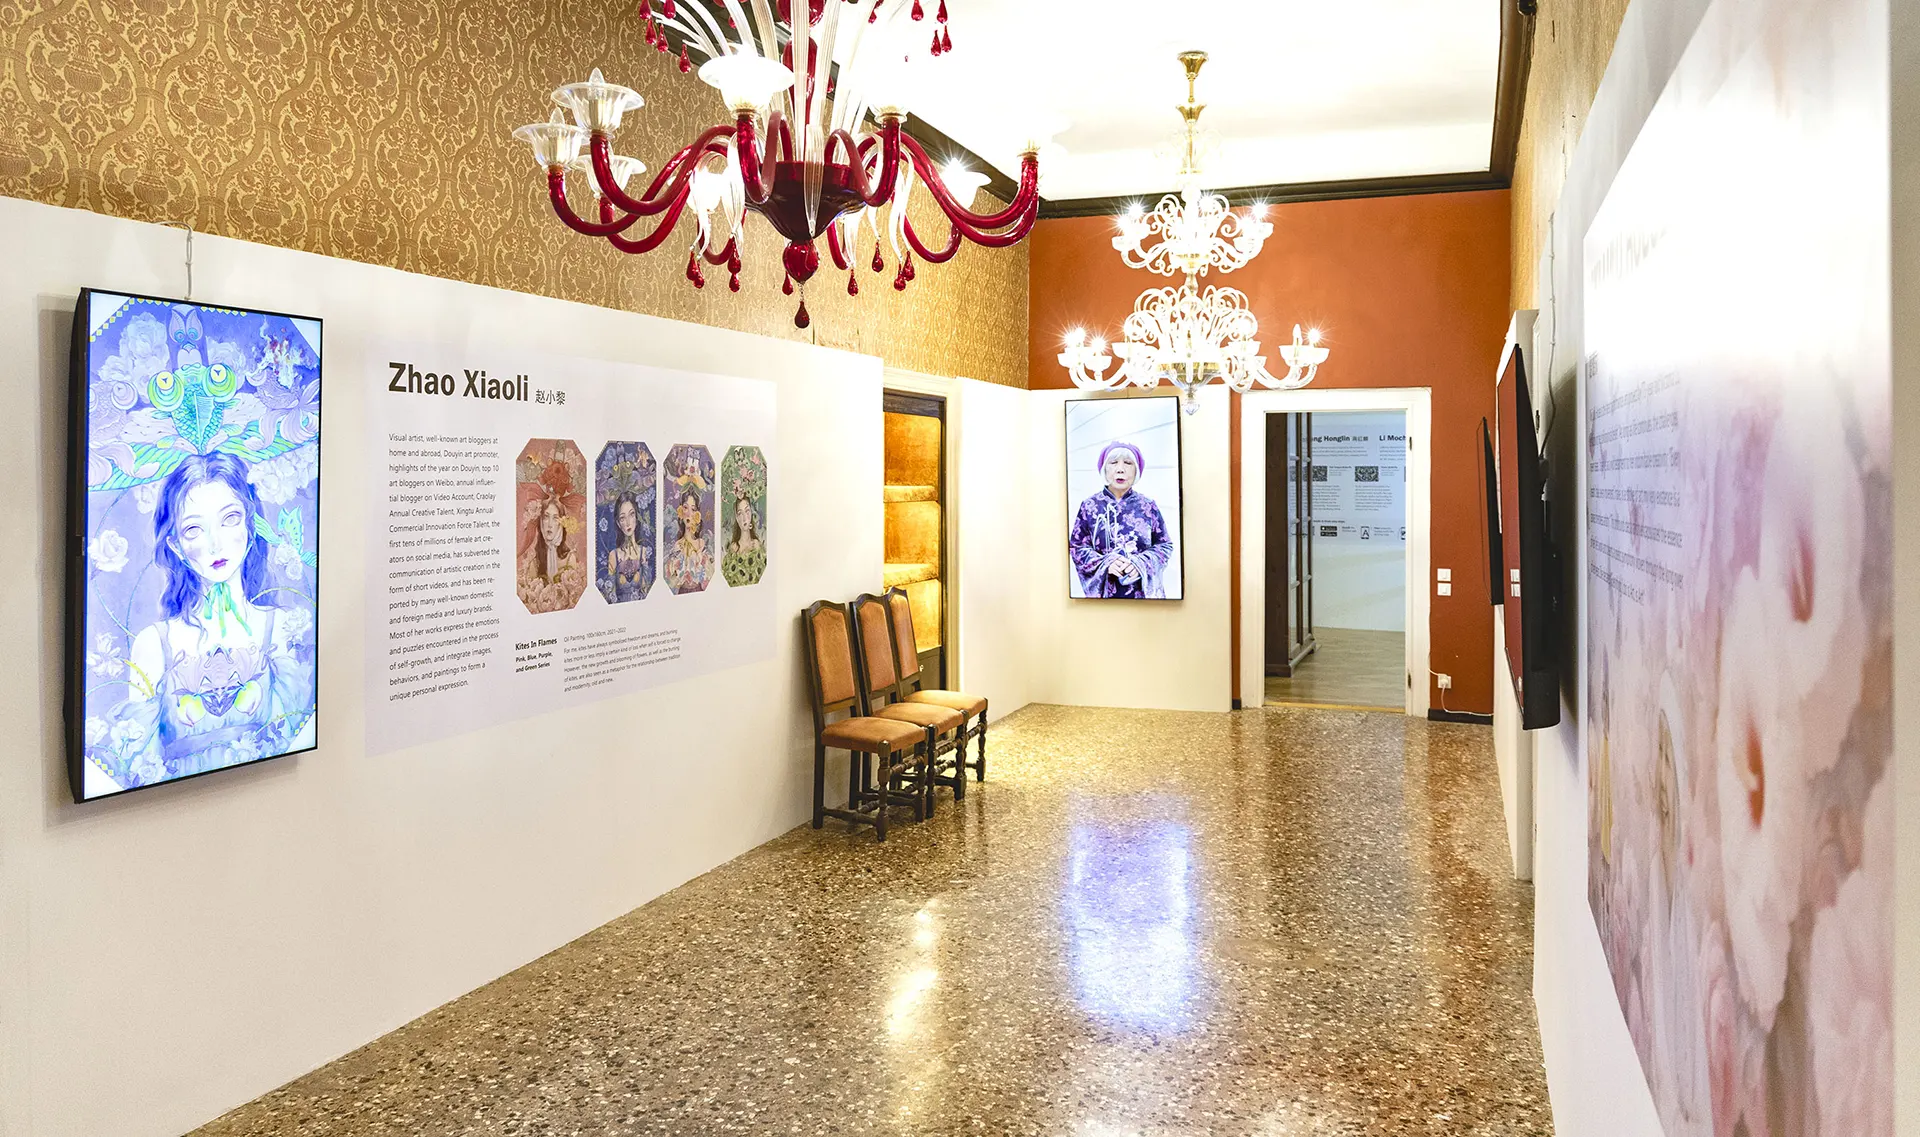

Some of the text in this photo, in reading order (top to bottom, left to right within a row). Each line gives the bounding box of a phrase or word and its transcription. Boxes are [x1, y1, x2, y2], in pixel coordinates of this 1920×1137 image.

[388, 362, 566, 405] Zhao Xiaoli 赵小黎
[468, 436, 491, 445] bloggers
[444, 450, 463, 459] Douyin
[389, 464, 418, 473] highlights
[399, 479, 425, 488] bloggers
[400, 495, 423, 503] blogger
[389, 524, 424, 532] Commercial
[389, 568, 434, 579] communication
[389, 585, 404, 594] form
[413, 583, 428, 591] short
[430, 582, 449, 590] videos,
[389, 601, 409, 610] ported
[411, 599, 418, 608] by
[437, 594, 468, 603] well-known
[389, 616, 401, 624] and
[403, 615, 424, 623] foreign
[456, 607, 472, 615] luxury
[474, 605, 492, 613] brands.
[425, 626, 442, 634] works
[443, 623, 464, 632] express
[476, 618, 499, 627] emotions
[389, 647, 401, 655] and
[403, 644, 424, 654] puzzles
[426, 639, 460, 649] encountered
[479, 632, 499, 642] process
[398, 657, 432, 669] self-growth,
[446, 651, 470, 660] integrate
[472, 648, 491, 657] images,
[390, 675, 420, 686] behaviors,
[434, 668, 459, 679] paintings
[390, 679, 468, 701] unique personal expression.
